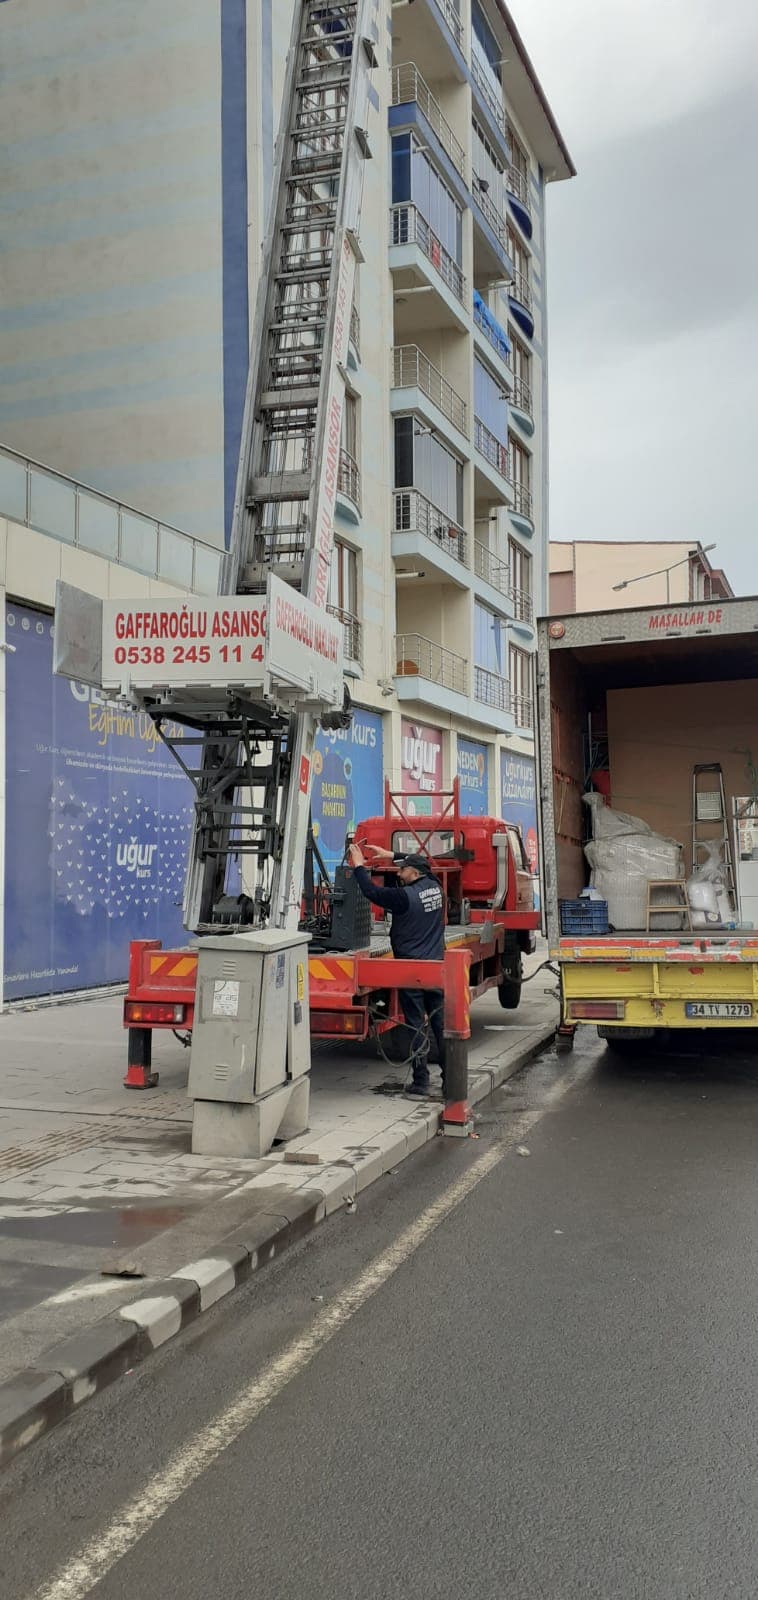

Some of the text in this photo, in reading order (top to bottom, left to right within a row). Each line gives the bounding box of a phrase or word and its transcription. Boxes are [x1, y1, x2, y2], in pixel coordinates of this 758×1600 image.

[115, 604, 207, 640] GAFFAROĞLU
[707, 608, 723, 624] DE
[114, 645, 165, 665] 0538
[172, 644, 211, 664] 245
[219, 644, 242, 663] 11
[351, 716, 377, 748] kurs
[402, 726, 440, 781] uğur
[116, 836, 158, 872] uğur
[693, 1004, 705, 1015] 34
[725, 1005, 750, 1016] 1279
